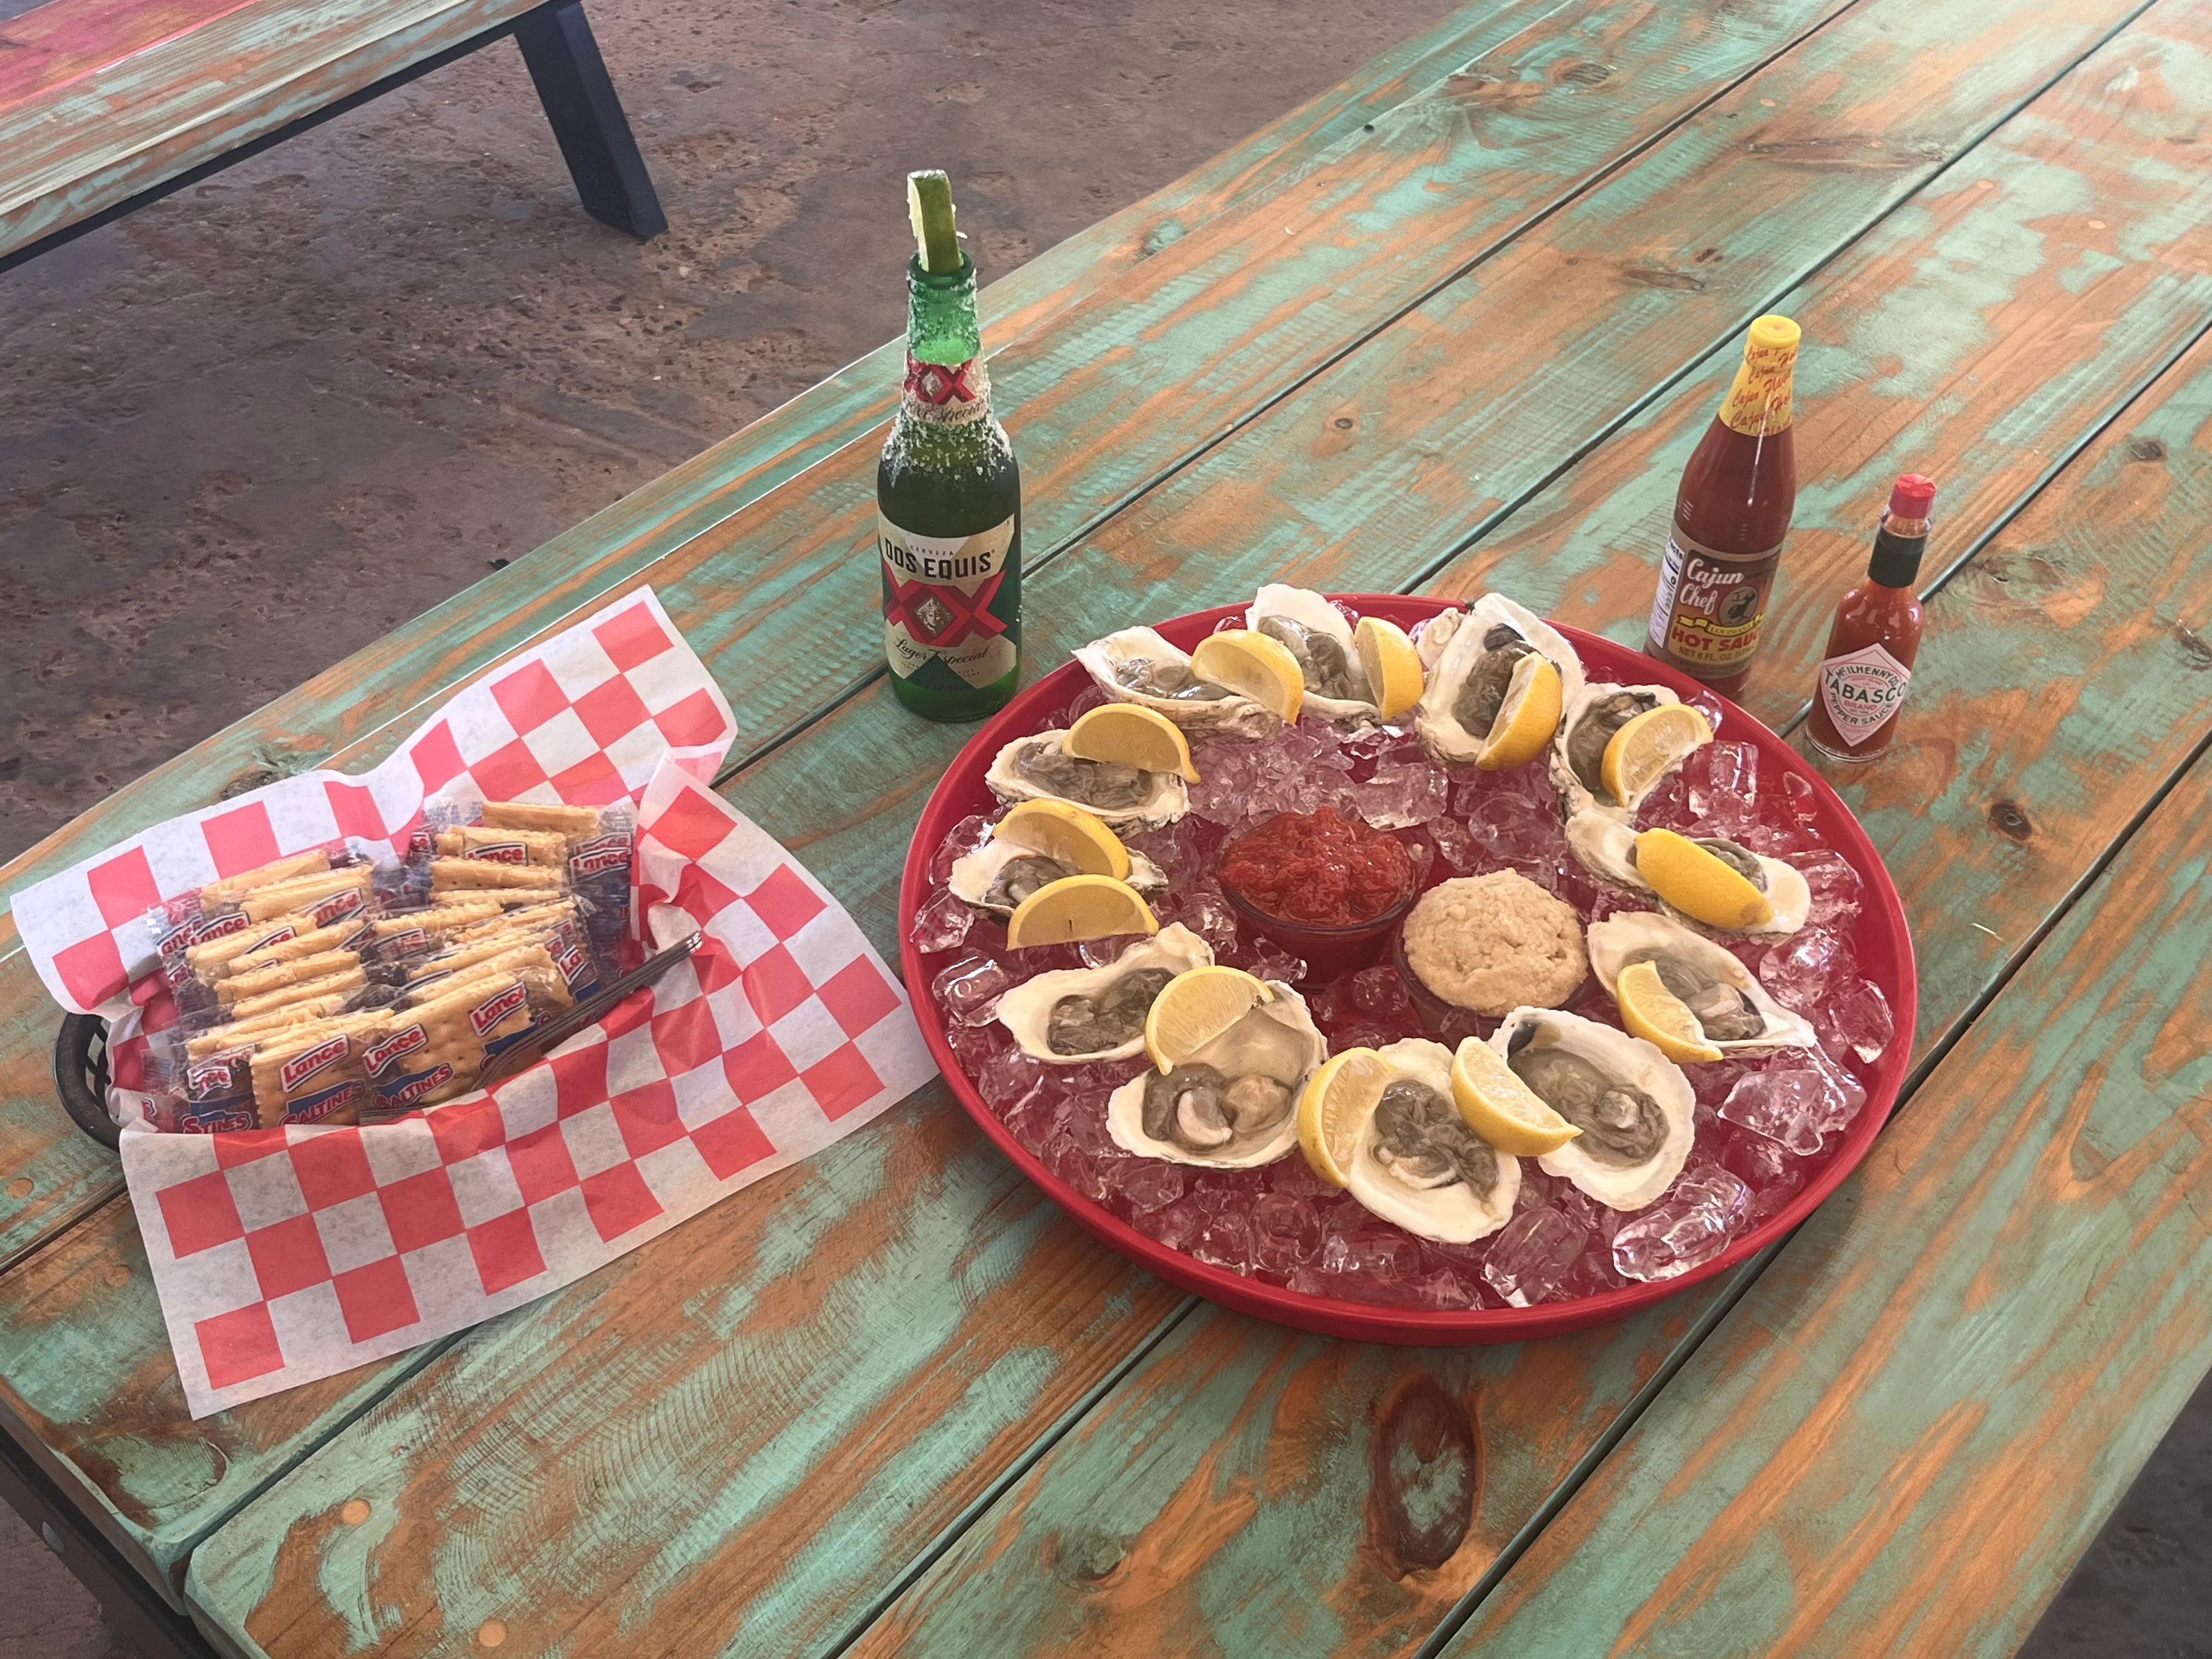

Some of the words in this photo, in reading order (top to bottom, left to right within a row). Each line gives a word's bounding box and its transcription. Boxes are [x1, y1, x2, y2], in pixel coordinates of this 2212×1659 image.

[885, 538, 917, 573] DOS
[924, 551, 991, 580] EQUIS
[1687, 558, 1745, 589] Cajun
[1679, 583, 1718, 616] Chef
[893, 636, 927, 659] Lager
[928, 645, 990, 664] Especial
[1672, 627, 1713, 651] HOT
[1825, 667, 1906, 703] TABASCO
[1830, 692, 1858, 725] PEPPER
[1861, 703, 1894, 725] SAUCE
[1844, 699, 1877, 710] BRAND
[283, 1041, 347, 1085] Lance
[364, 1029, 425, 1071] Lance
[281, 1081, 363, 1125] SALTINES
[374, 1065, 452, 1109] SALTINES
